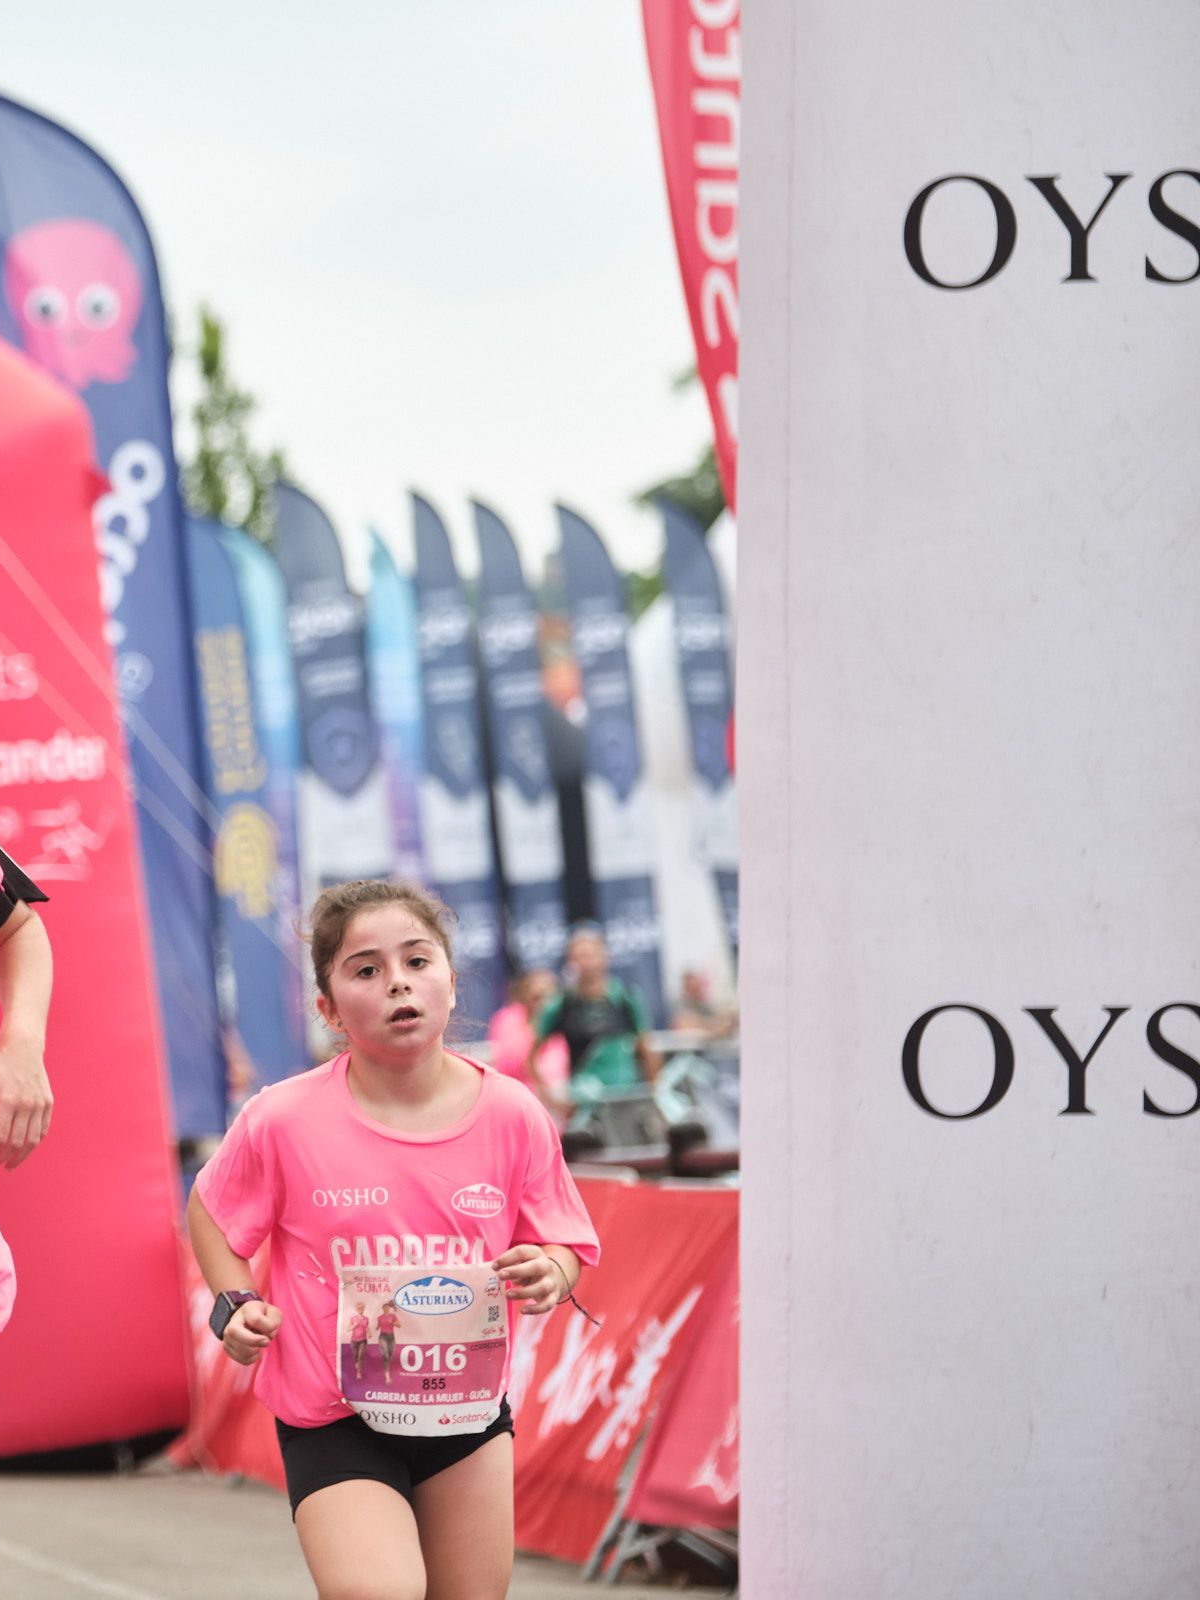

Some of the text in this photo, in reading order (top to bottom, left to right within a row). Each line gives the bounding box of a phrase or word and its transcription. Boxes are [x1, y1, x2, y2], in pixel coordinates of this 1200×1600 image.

[312, 1187, 389, 1207] OYSHO
[356, 1282, 391, 1294] SUMA
[400, 1292, 469, 1306] ASTURIANA
[399, 1344, 467, 1372] 016
[422, 1378, 446, 1391] 855
[364, 1390, 406, 1402] CARRERA
[408, 1394, 420, 1403] DE
[423, 1394, 435, 1403] LA
[436, 1392, 464, 1403] MUJER
[359, 1409, 417, 1426] OYSHO
